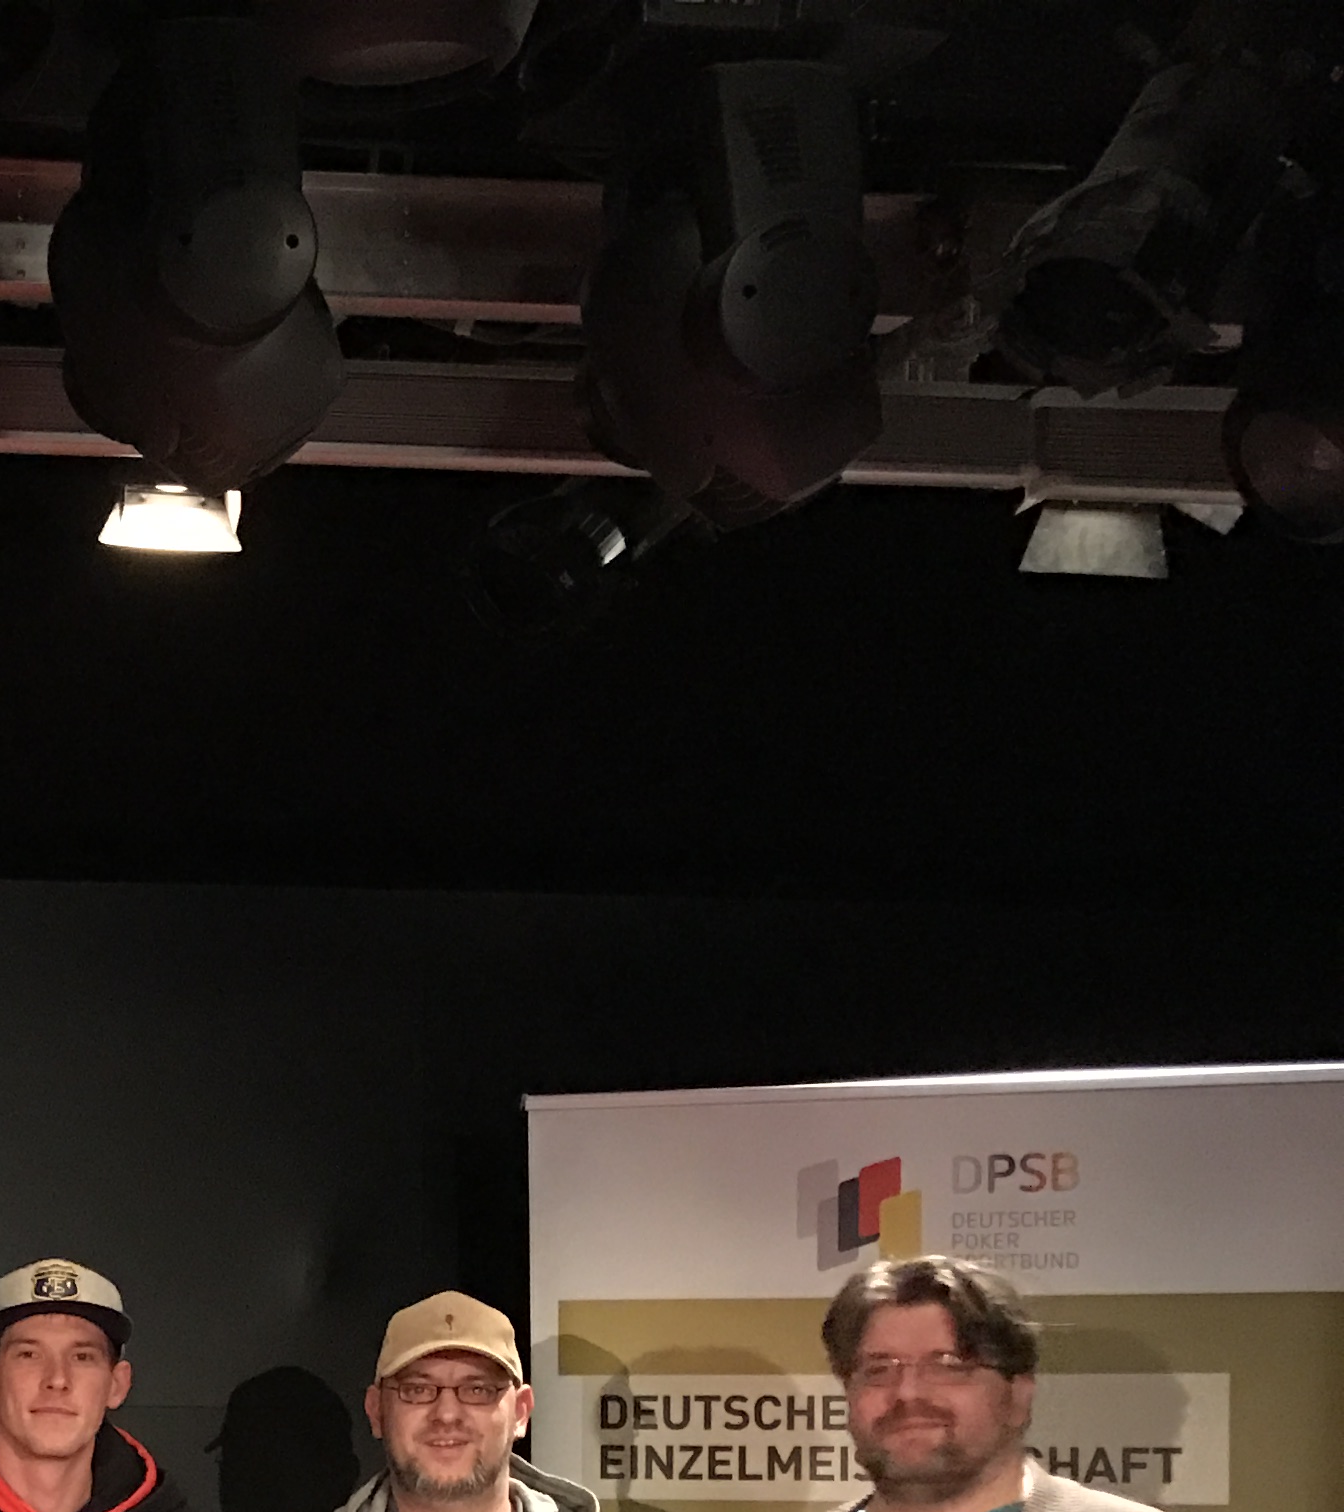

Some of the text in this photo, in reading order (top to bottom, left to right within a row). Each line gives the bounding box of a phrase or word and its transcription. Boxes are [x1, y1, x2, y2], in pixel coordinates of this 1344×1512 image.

[952, 1151, 1081, 1195] DPSB
[951, 1210, 1077, 1230] DEUTSCHER
[951, 1232, 1020, 1250] POKER
[600, 1395, 847, 1430] DEUTSCHE
